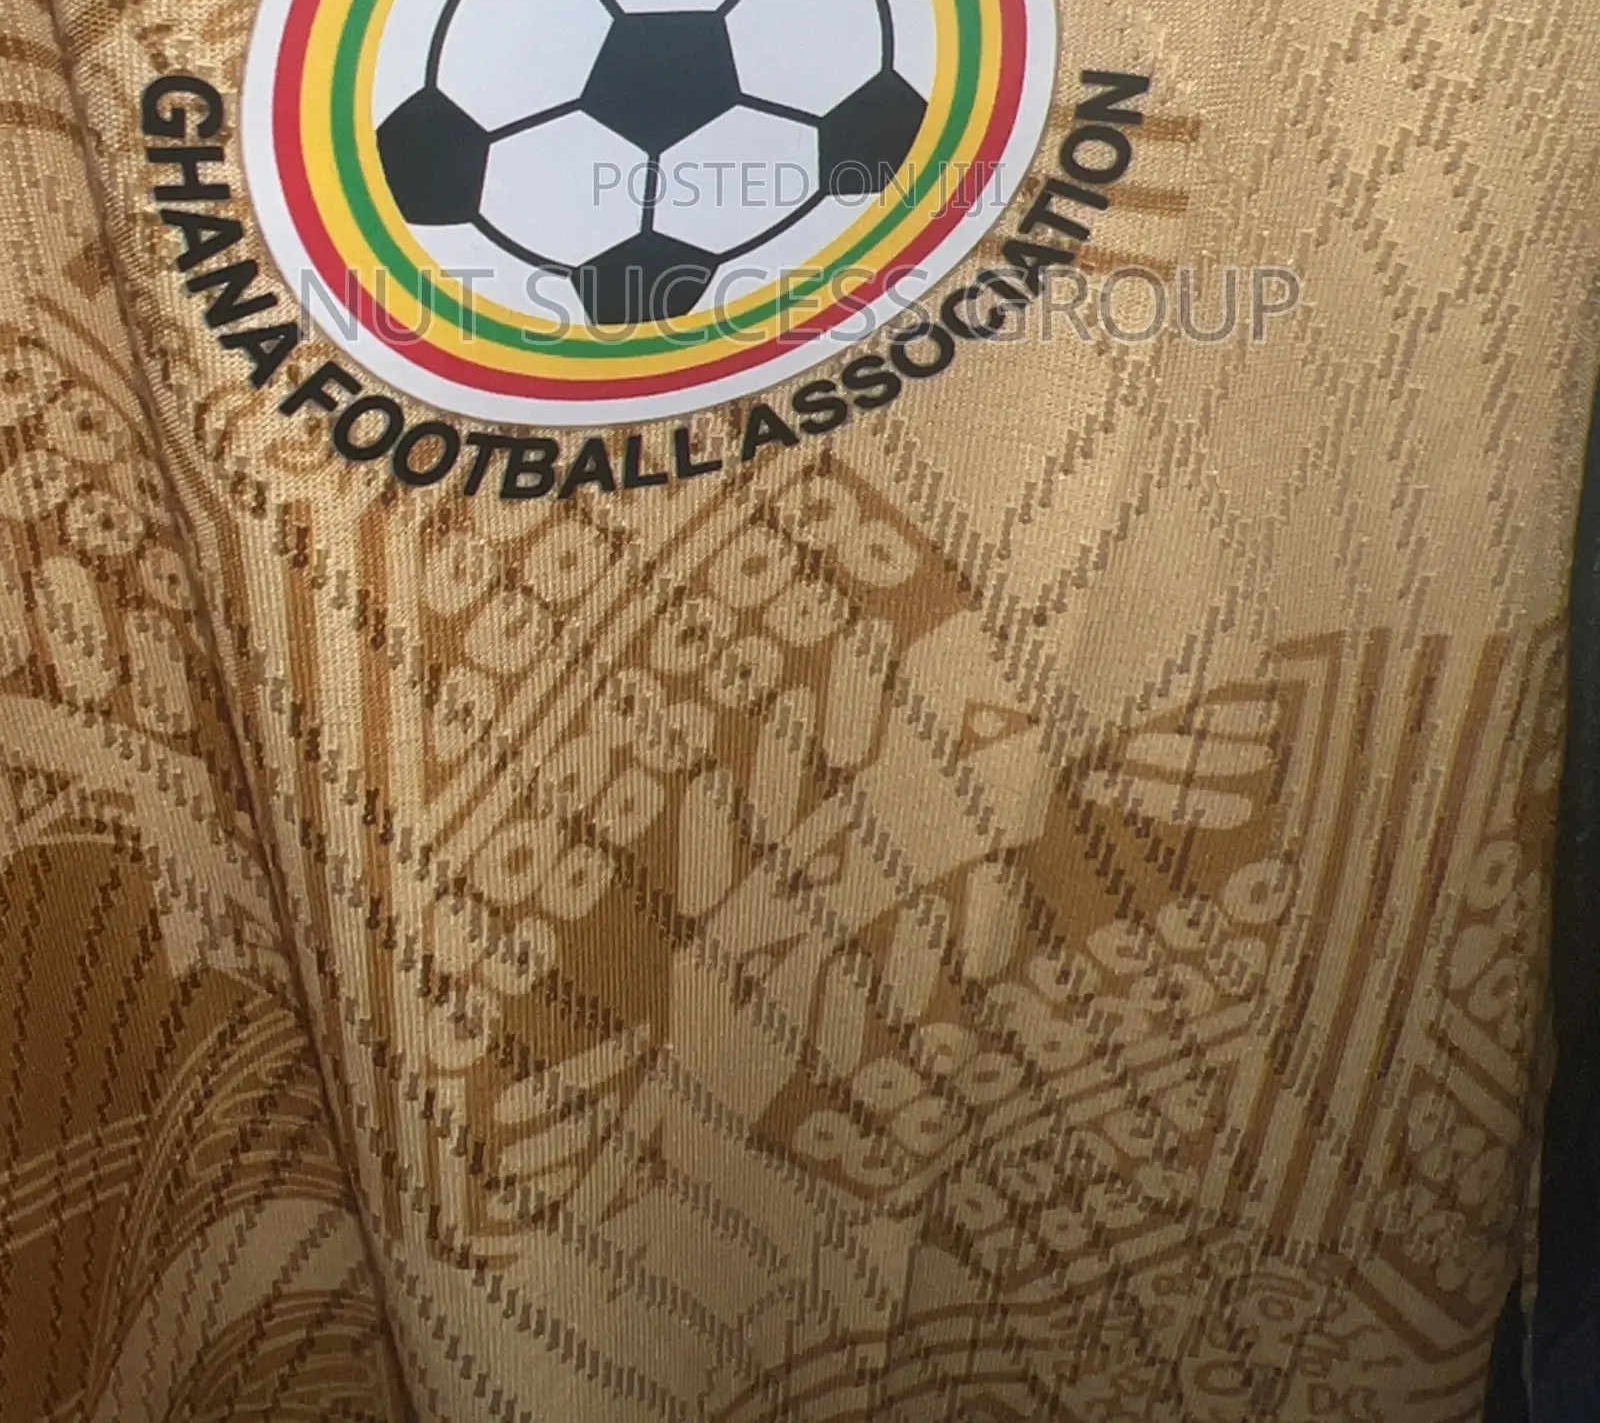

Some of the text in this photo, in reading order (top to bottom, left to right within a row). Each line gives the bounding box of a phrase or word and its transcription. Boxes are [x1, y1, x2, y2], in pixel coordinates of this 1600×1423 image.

[140, 68, 1151, 500] GHANA FOOTBALL ASSOCIATION
